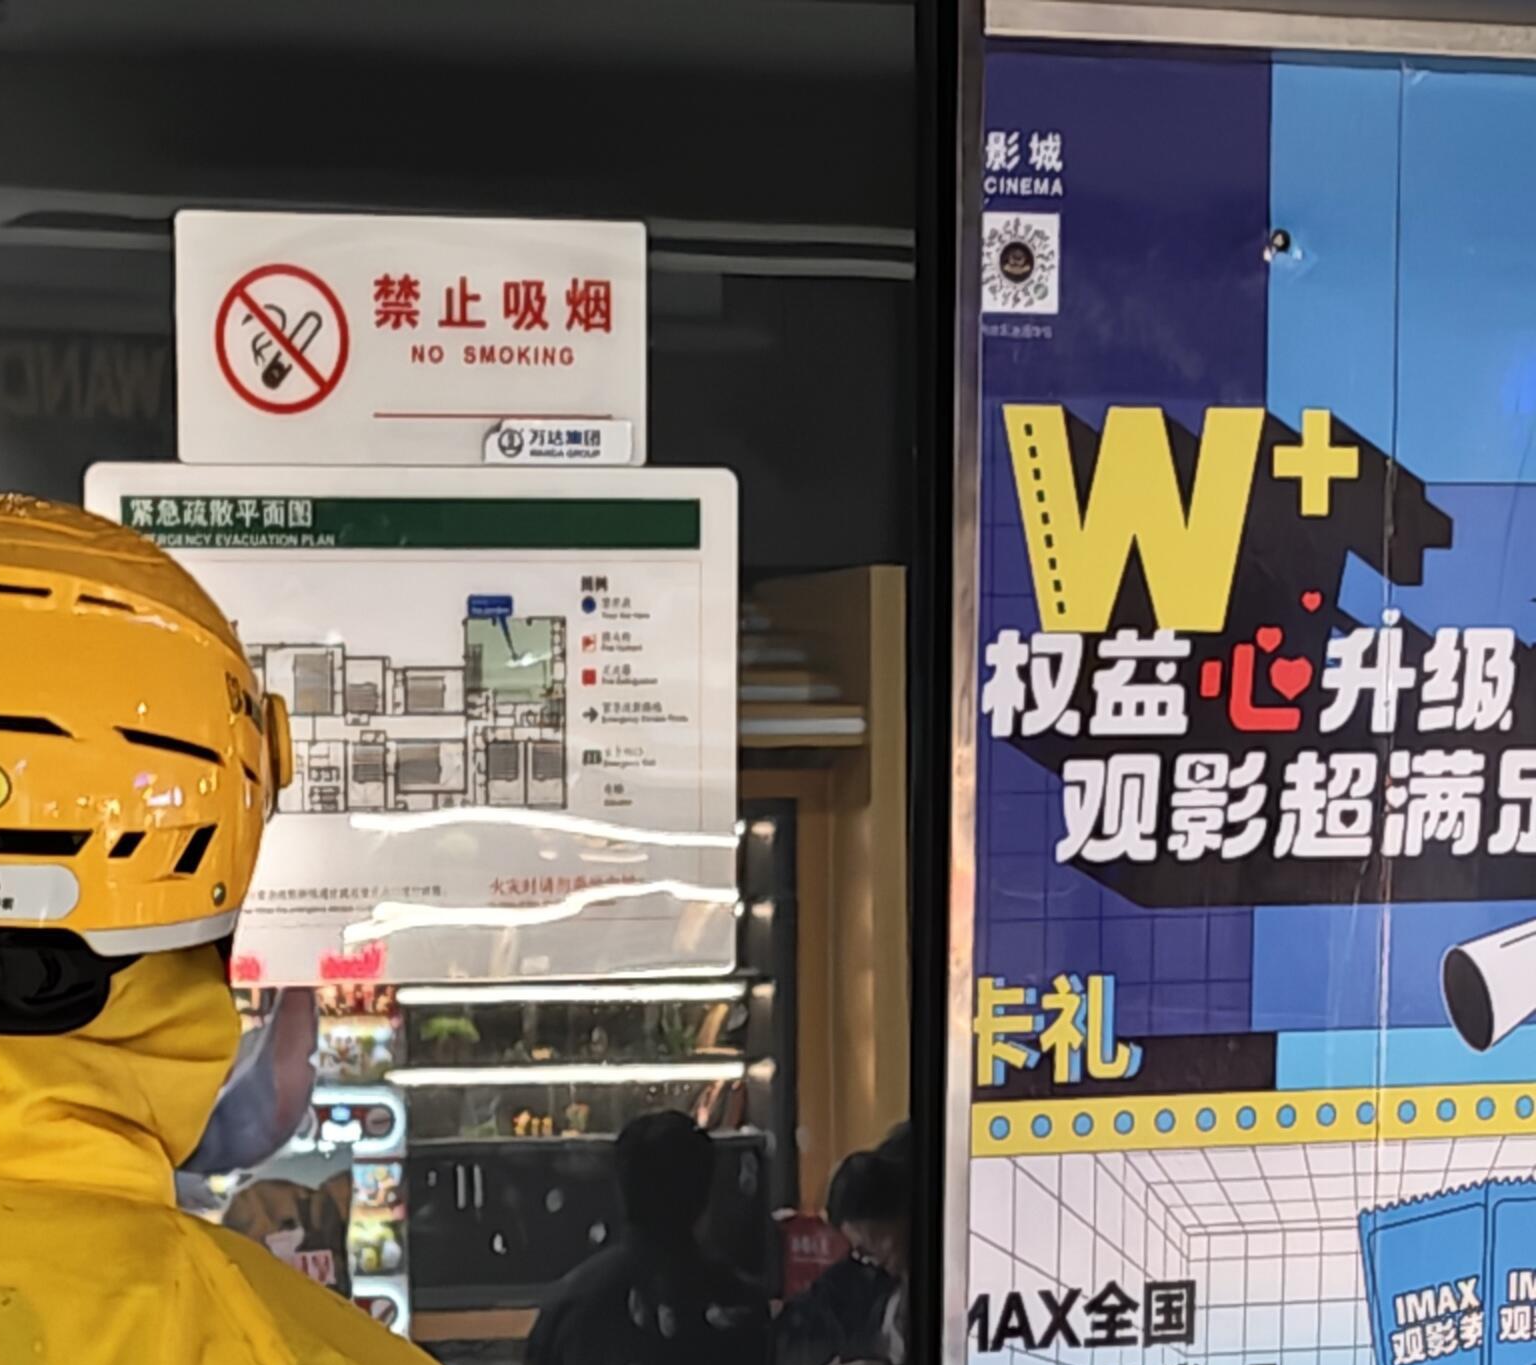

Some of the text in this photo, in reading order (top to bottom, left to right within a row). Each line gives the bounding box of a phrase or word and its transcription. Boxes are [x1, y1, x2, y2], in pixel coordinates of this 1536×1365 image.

[985, 130, 1064, 172] 影城
[983, 176, 1064, 197] CINEMA
[372, 273, 613, 334] 禁止吸烟
[410, 345, 575, 367] NO SMOKING
[528, 428, 602, 447] 万达集团
[130, 498, 313, 528] 紧急疏散平面图
[215, 533, 298, 547] EVACUATION
[301, 533, 336, 547] PLAN
[981, 627, 1517, 738] 权益心升级
[972, 973, 1142, 1086] 卡礼
[1395, 1276, 1481, 1326] IMAX
[1498, 1304, 1536, 1341] 观
